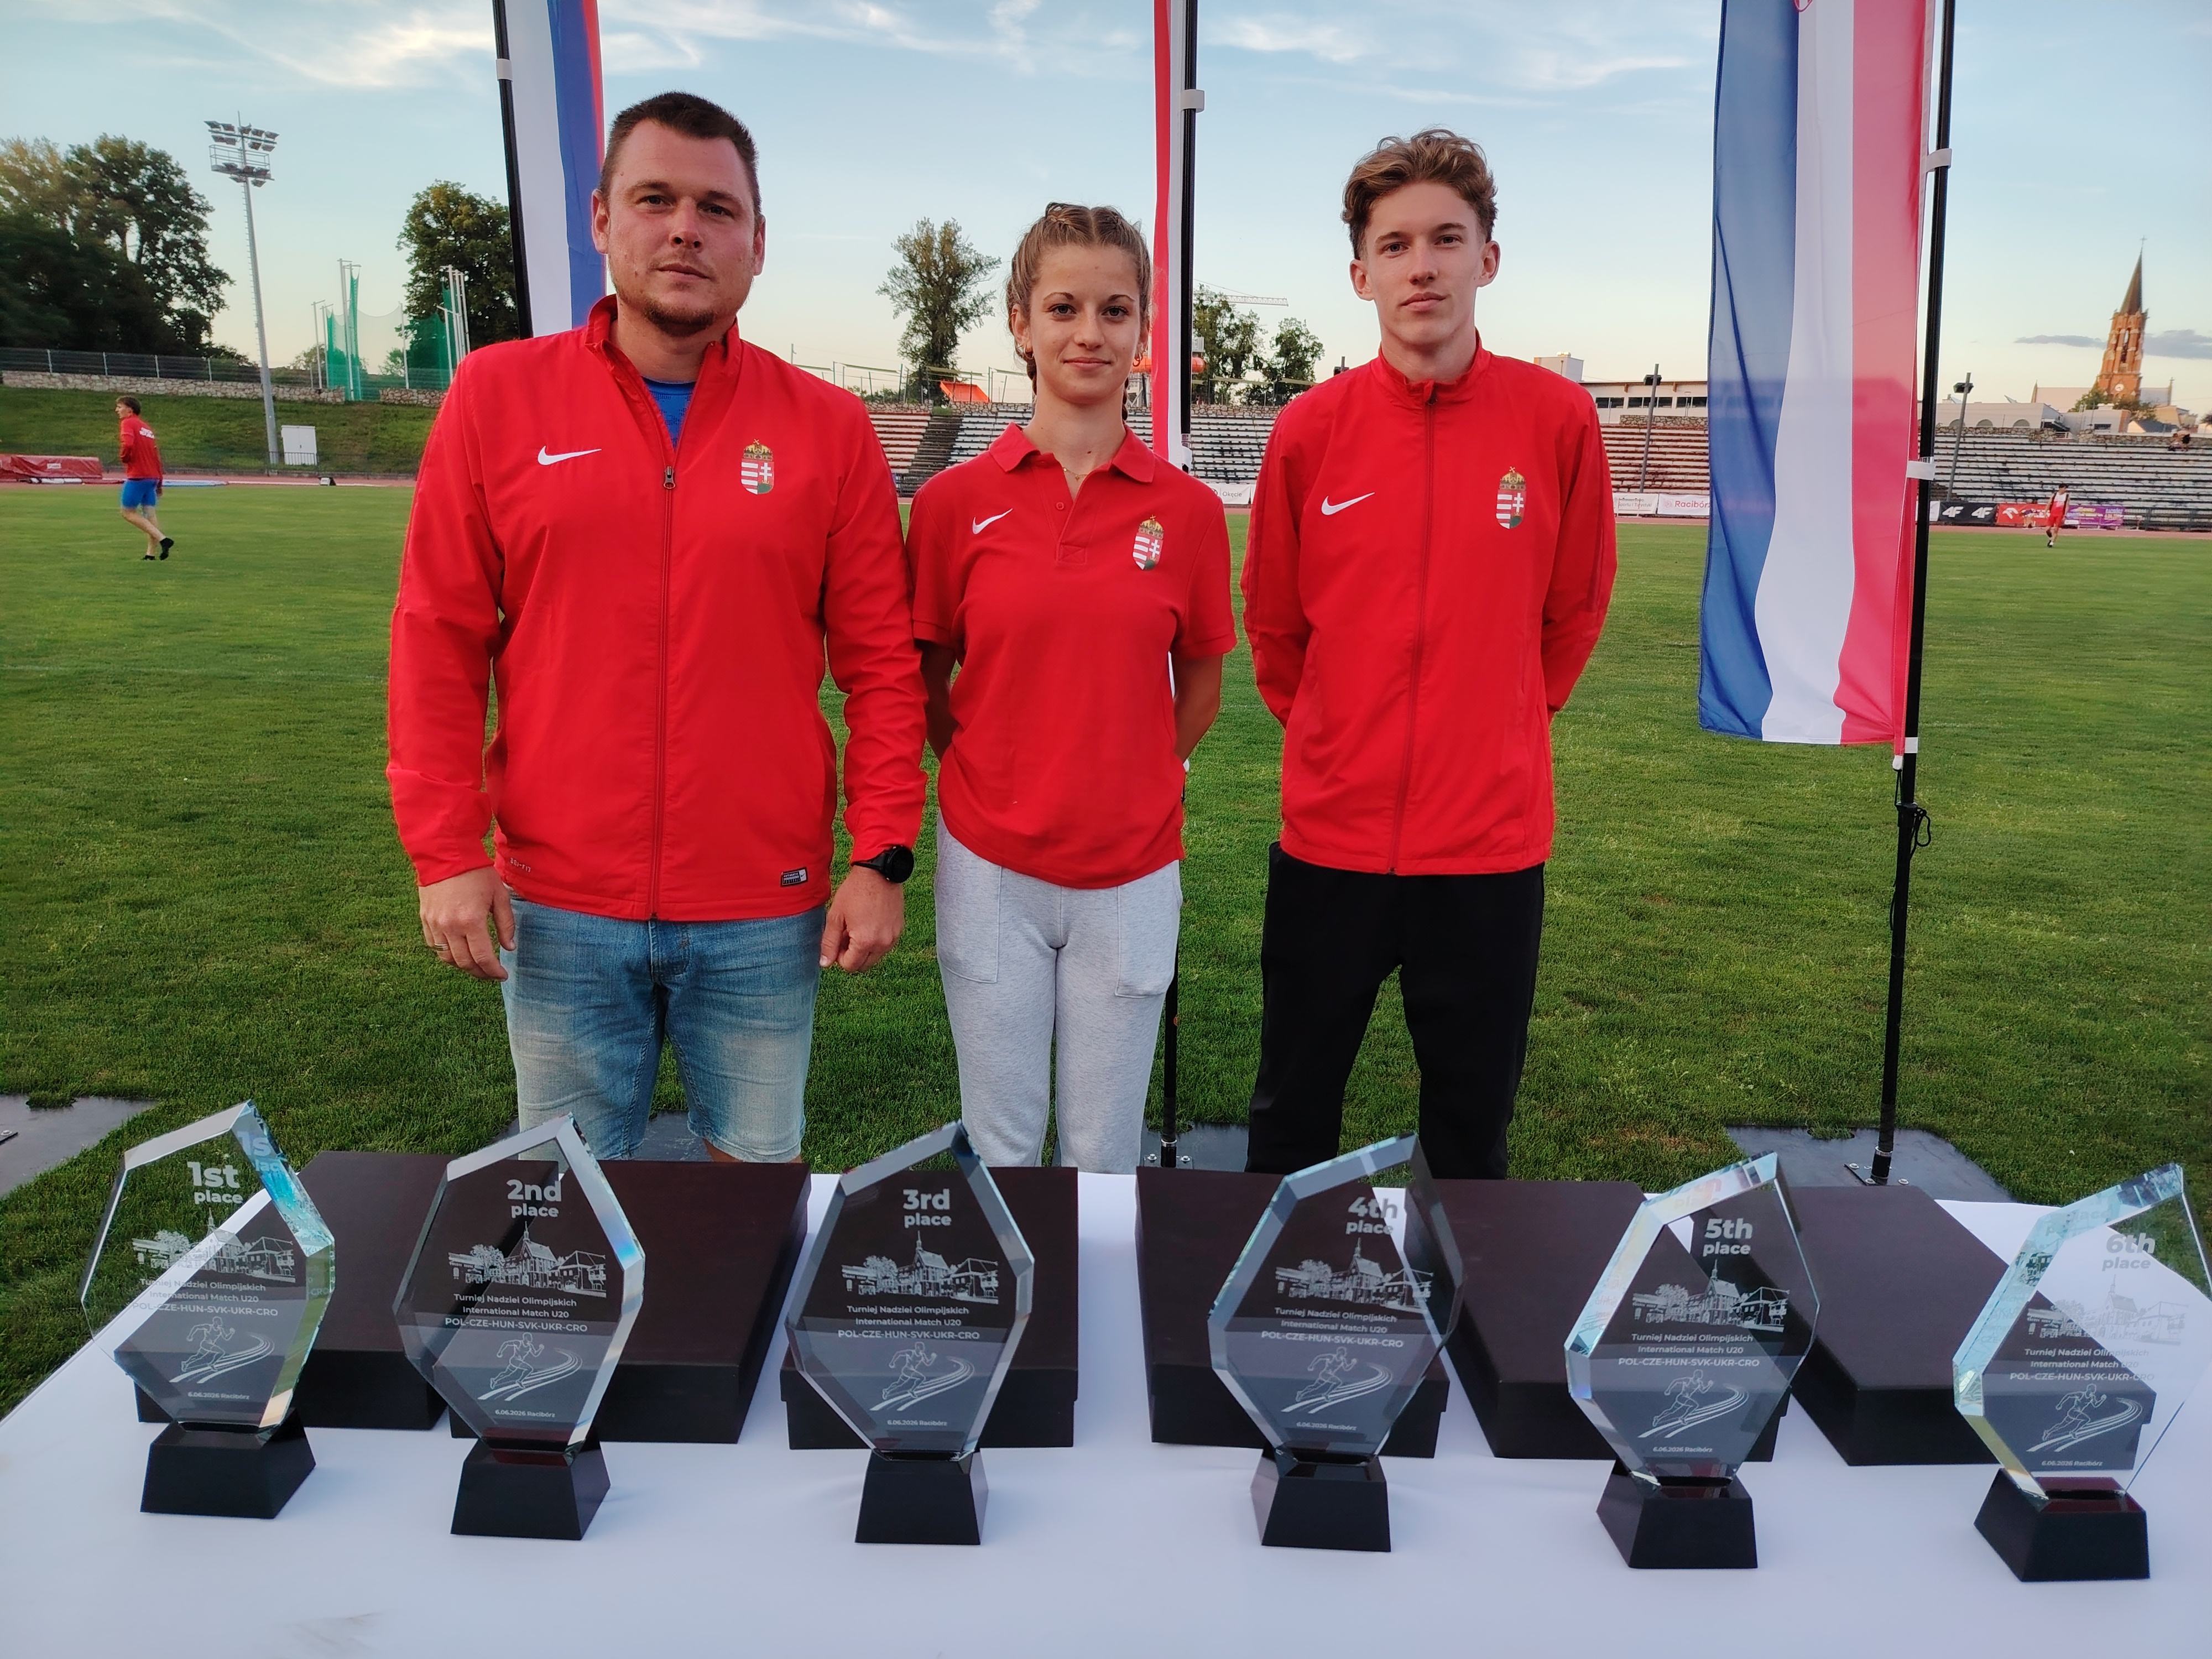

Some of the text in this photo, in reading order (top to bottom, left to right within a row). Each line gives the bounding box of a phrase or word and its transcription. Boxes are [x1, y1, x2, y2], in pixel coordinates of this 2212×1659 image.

[1942, 506, 1964, 518] 4F
[1971, 507, 1993, 519] 4F
[187, 1161, 240, 1188] 1st
[195, 1190, 243, 1204] place
[507, 1179, 562, 1202] 2nd
[903, 1188, 950, 1210] 3rd
[511, 1203, 559, 1218] place
[1348, 1196, 1398, 1218] 4th
[904, 1212, 952, 1228] place
[1345, 1219, 1394, 1234] place
[1704, 1218, 1753, 1239] 5th
[1703, 1241, 1751, 1257] place
[2106, 1233, 2156, 1254] 6th
[2102, 1257, 2151, 1271] place
[139, 1278, 266, 1291] Turniej Nadziei Olimpijskich
[150, 1291, 208, 1300] International
[453, 1293, 577, 1307] Turniej Nadziei Olimpijskich
[133, 1302, 278, 1316] POL-CZE-HUN-SVK-UKR-CRO
[463, 1306, 520, 1316] International
[522, 1308, 549, 1317] Match
[847, 1305, 878, 1314] Turniej
[914, 1306, 969, 1316] Olimpijskich
[1275, 1307, 1397, 1323] Turniej Nadziei Olimpijskich
[445, 1317, 588, 1332] POL-CZE-HUN-SVK-UKR-CRO
[855, 1317, 912, 1326] International
[914, 1318, 941, 1326] Match
[1281, 1320, 1338, 1330] International
[1339, 1323, 1367, 1332] Match
[838, 1329, 980, 1339] POL-CZE-HUN-SVK-UKR-CRO
[1261, 1331, 1404, 1348] POL-CZE-HUN-SVK-UKR-CRO
[1631, 1333, 1754, 1343] Turniej Nadziei Olimpijskich
[2025, 1348, 2056, 1357] Turniej
[2093, 1348, 2150, 1358] Olimpijskich
[1618, 1358, 1760, 1367] POL-CZE-HUN-SVK-UKR-CRO
[2010, 1373, 2154, 1381] POL-CZE-HUN-SVK-UKR-CRO
